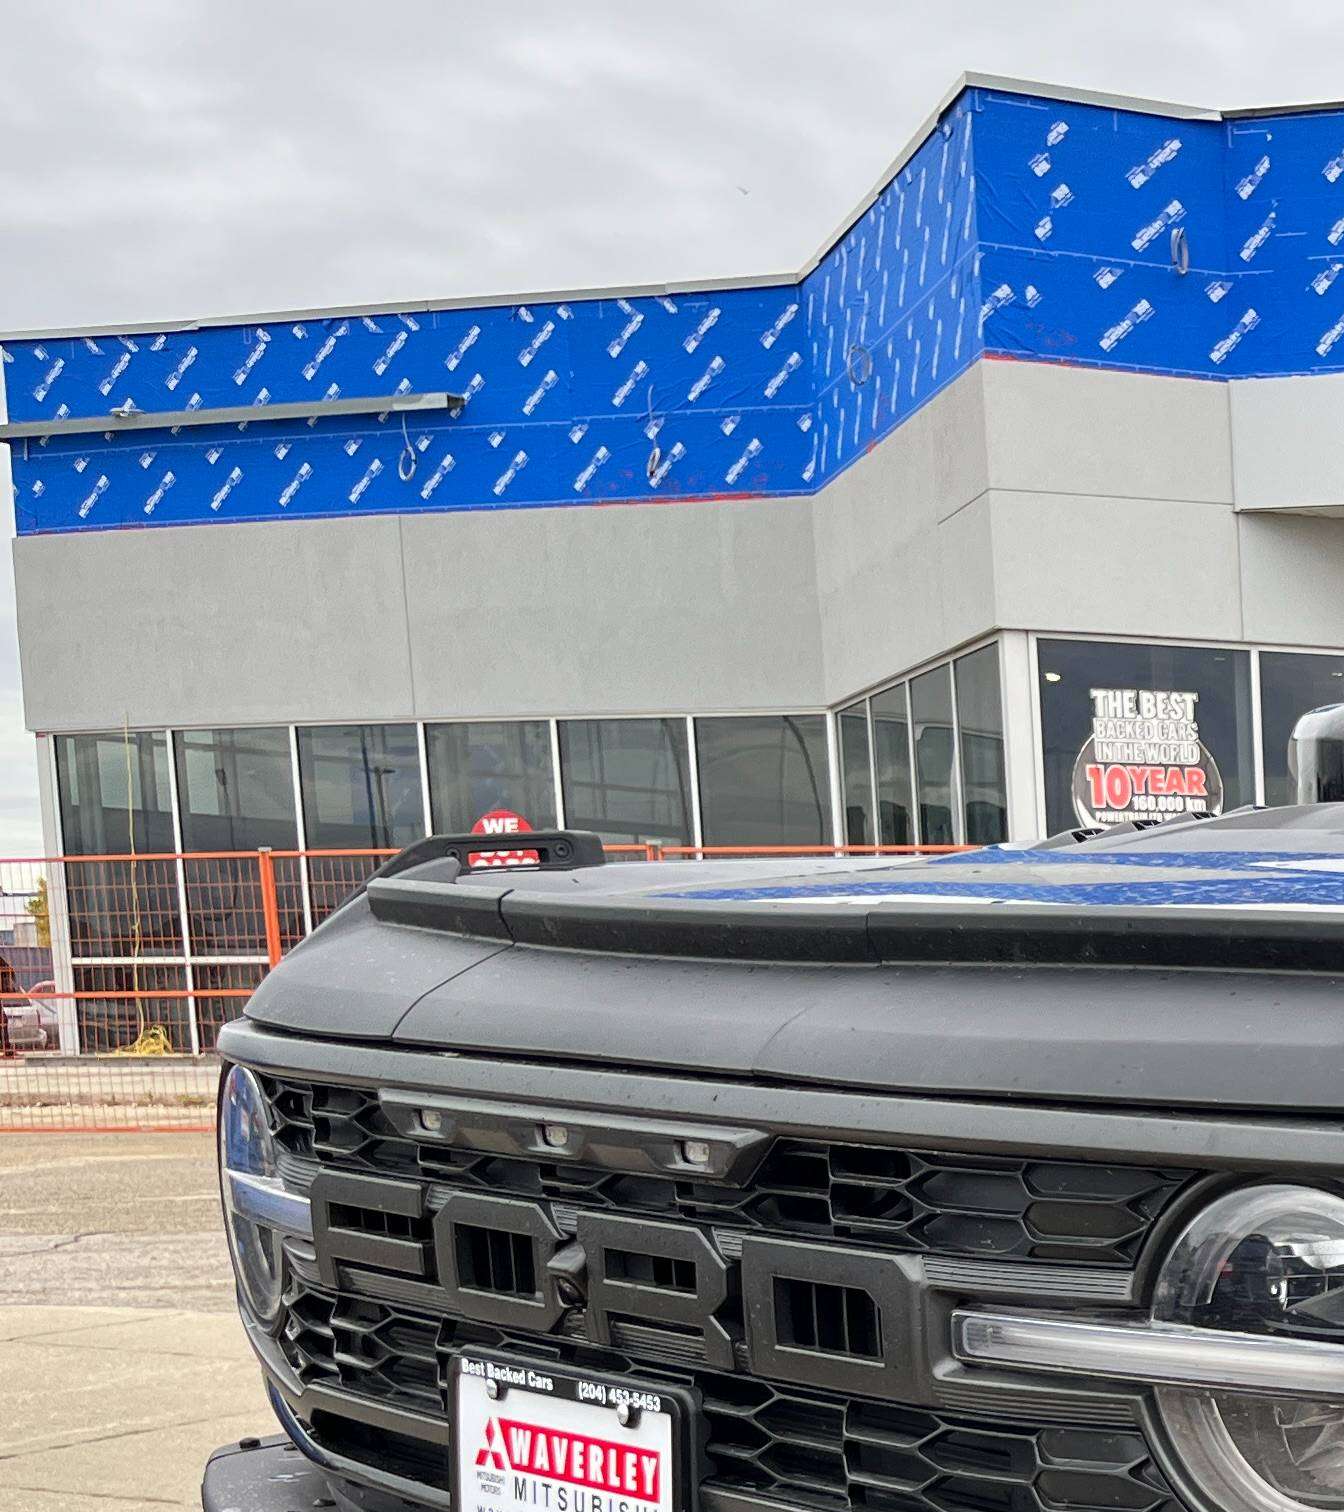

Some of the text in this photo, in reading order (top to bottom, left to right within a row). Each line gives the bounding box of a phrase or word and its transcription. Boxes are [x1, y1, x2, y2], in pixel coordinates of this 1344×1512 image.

[1090, 689, 1199, 721] THE BEST
[1096, 720, 1199, 741] BACKED CARS
[1097, 742, 1200, 764] IN THE WORLD
[1087, 764, 1209, 809] 10 YEAR
[1132, 795, 1207, 812] 160,000 km
[482, 817, 519, 834] WE
[310, 1166, 929, 1390] FORD
[461, 1358, 661, 1412] Best Backed Cars (204) 453-5453
[510, 1426, 658, 1496] WAVERLEY
